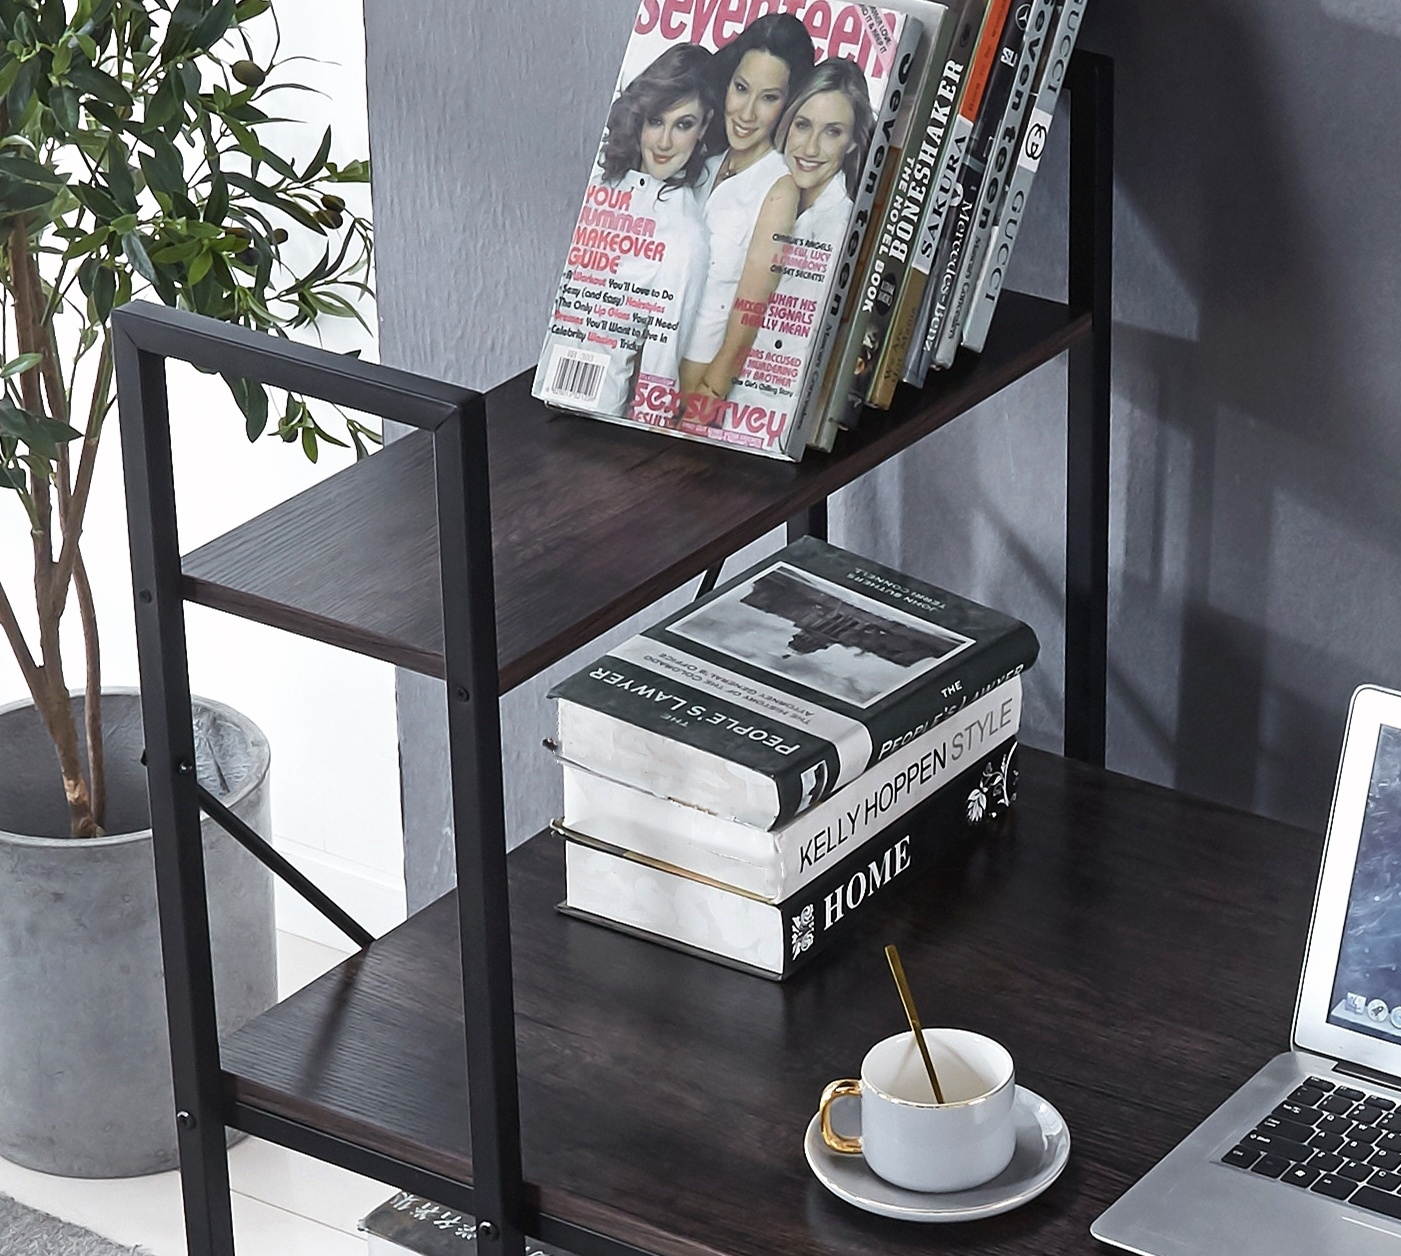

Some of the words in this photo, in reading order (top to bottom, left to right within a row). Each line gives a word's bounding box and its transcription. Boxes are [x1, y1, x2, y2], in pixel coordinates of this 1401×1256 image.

[634, 0, 897, 80] seveeen
[1047, 0, 1083, 94] UCCI
[889, 59, 965, 264] BONESHAKER
[899, 156, 916, 191] THE
[921, 135, 967, 259] SAKURA
[567, 247, 621, 275] GUIDE
[574, 226, 667, 262] MAKEOVER
[923, 200, 973, 352] Mercedes-Benz
[985, 190, 1024, 302] GUCCI
[863, 259, 885, 313] BOOK
[589, 667, 688, 711] LAWYER
[941, 680, 963, 698] THE
[687, 704, 801, 756] PEOPLE'S
[799, 803, 861, 874] KELLY
[864, 742, 947, 826] HOPPEN
[951, 698, 1014, 760] STYLE
[823, 835, 912, 931] HOME
